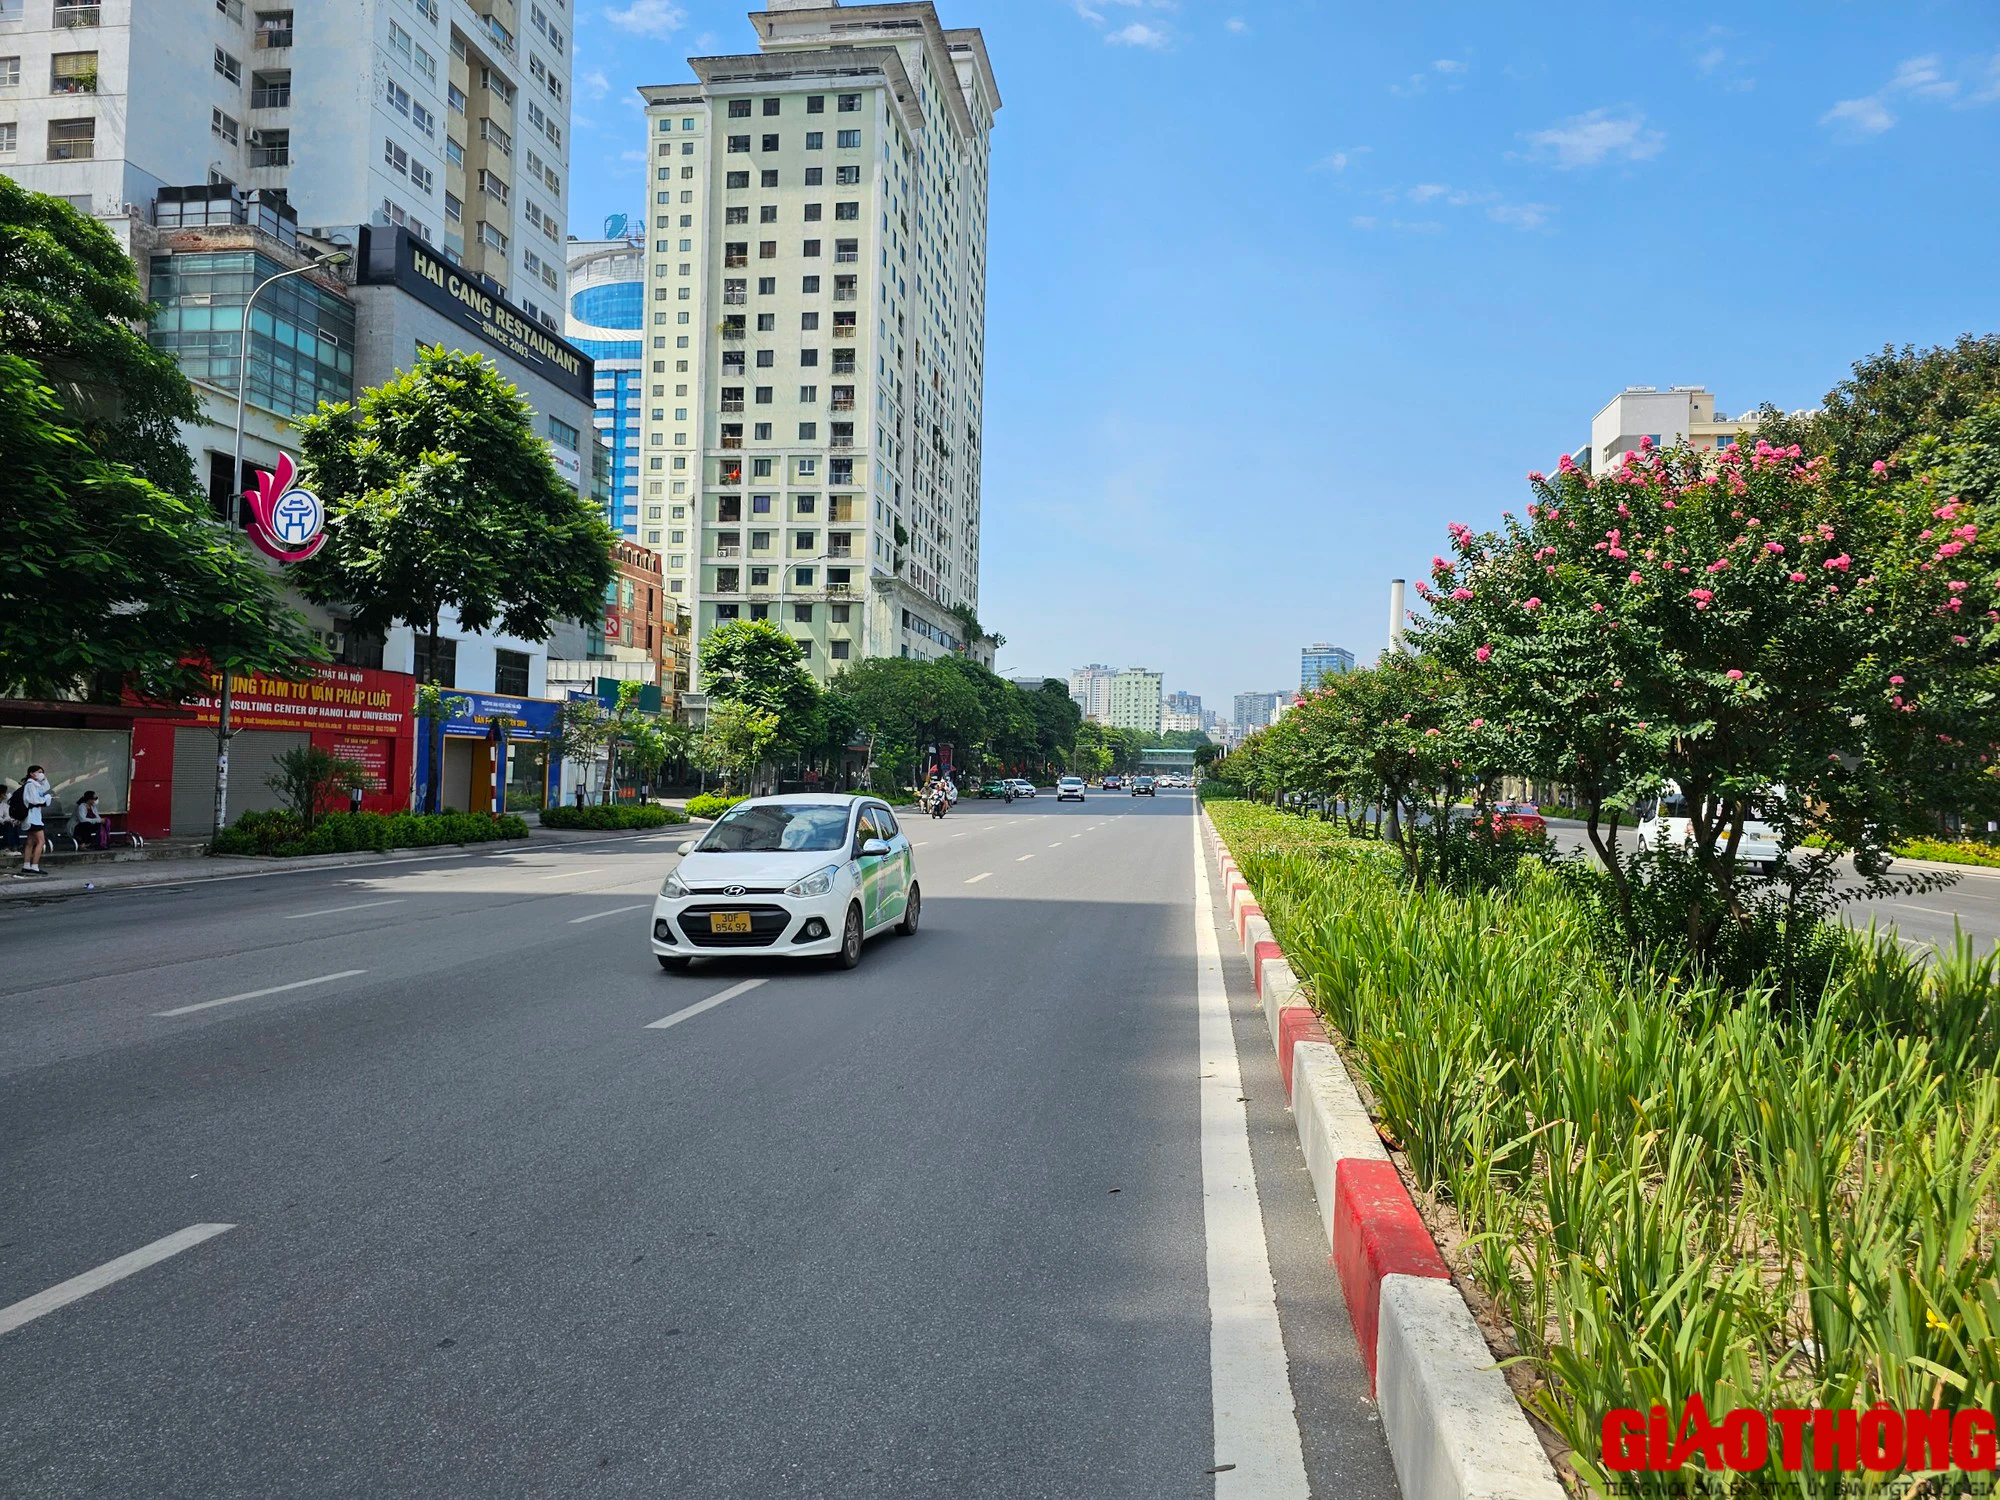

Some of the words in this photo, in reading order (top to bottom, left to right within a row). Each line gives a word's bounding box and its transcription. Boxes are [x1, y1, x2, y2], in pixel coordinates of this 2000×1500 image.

[414, 250, 444, 288] HAI
[448, 275, 492, 318] CANG
[495, 306, 580, 376] RESTAURANT
[482, 320, 509, 346] SINCE
[509, 338, 529, 359] 2003
[338, 669, 348, 681] HÀ
[350, 671, 363, 683] NỘI
[292, 683, 309, 699] TƯ
[311, 681, 333, 702] VẤN
[336, 687, 365, 704] PHÁP
[367, 690, 392, 709] LUẬT
[274, 703, 306, 715] CENTER
[308, 706, 318, 715] OF
[319, 707, 343, 717] HANOI
[344, 709, 361, 719] LAW
[362, 710, 402, 722] UNIVERSITY
[715, 923, 747, 932] 854.92
[721, 914, 738, 922] 30F
